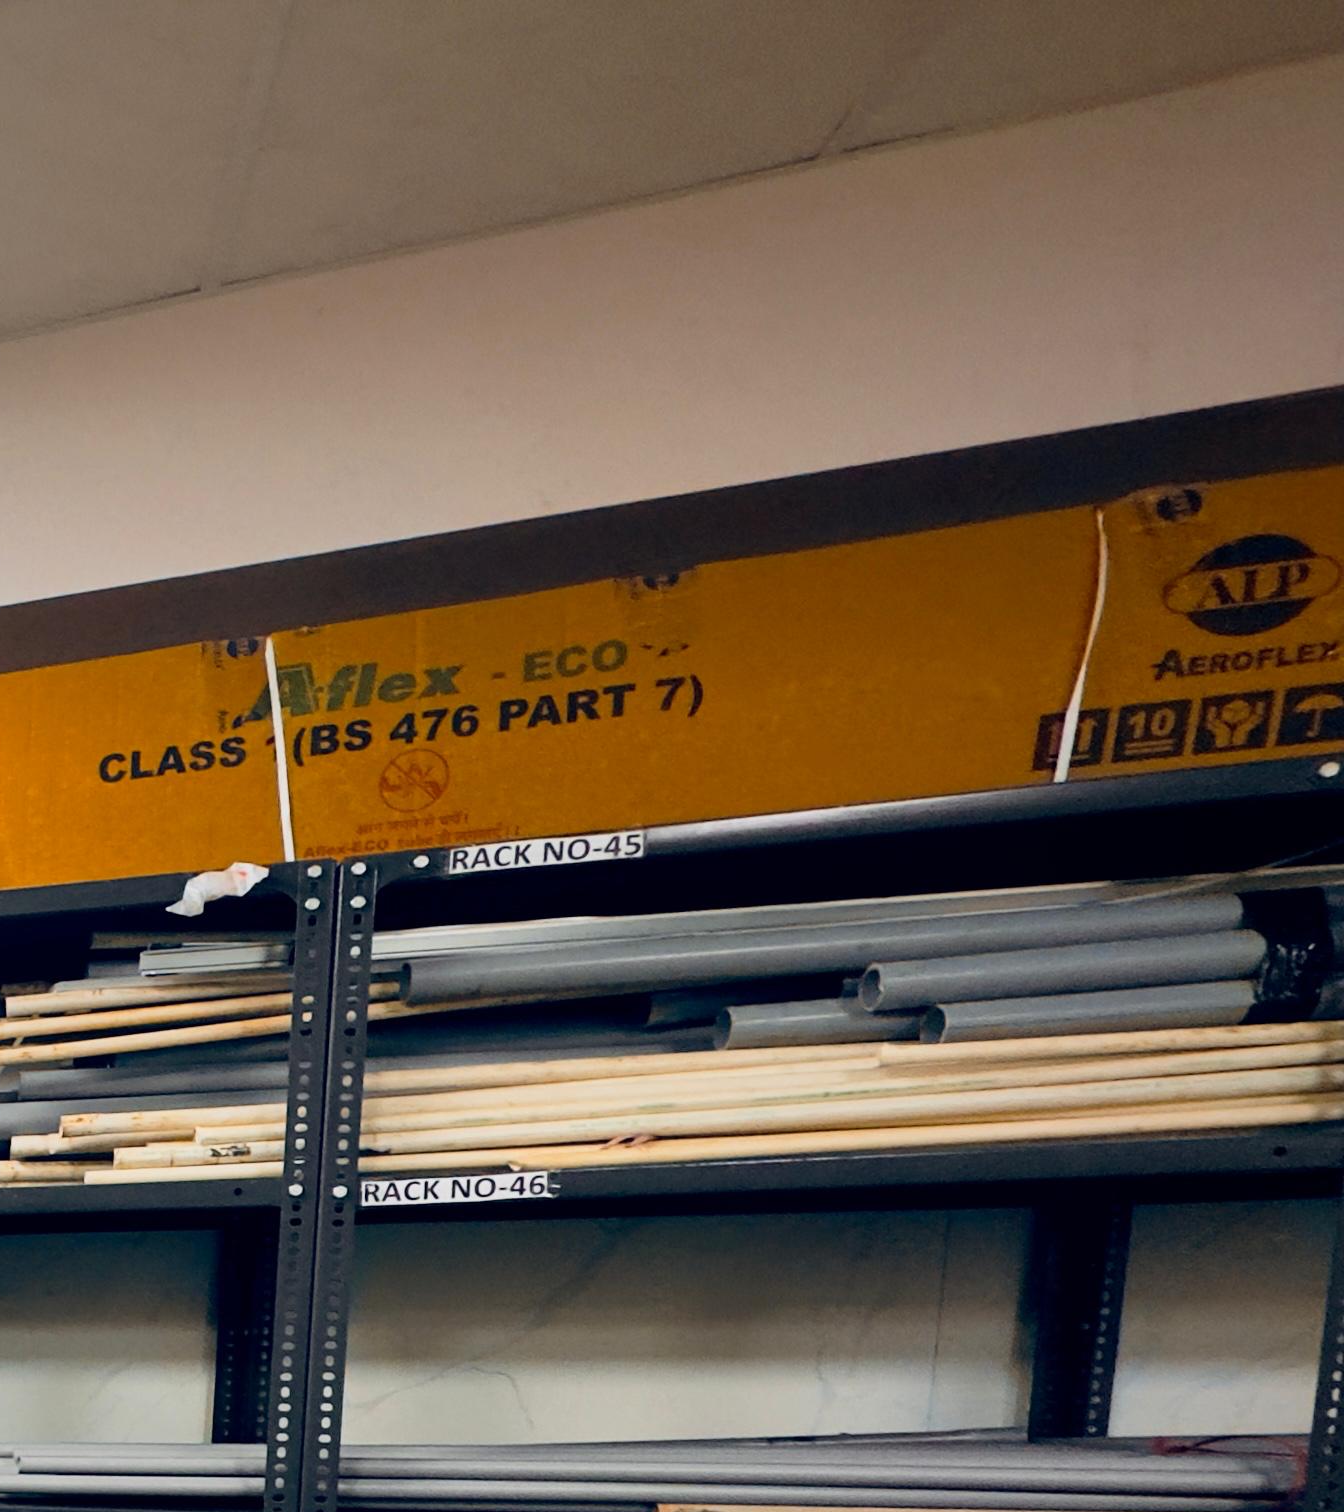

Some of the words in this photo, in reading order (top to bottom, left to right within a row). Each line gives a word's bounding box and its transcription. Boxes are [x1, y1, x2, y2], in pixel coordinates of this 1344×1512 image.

[1197, 560, 1310, 609] ALP
[523, 638, 629, 684] ECO
[98, 735, 248, 783] CLASS
[292, 719, 374, 768] (BS
[389, 704, 481, 746] 476
[498, 683, 636, 734] PART
[656, 674, 705, 718] 7)
[451, 844, 532, 872] RACK
[542, 834, 642, 862] NO-45
[363, 1180, 440, 1202] RACK
[451, 1175, 546, 1199] NO-46
